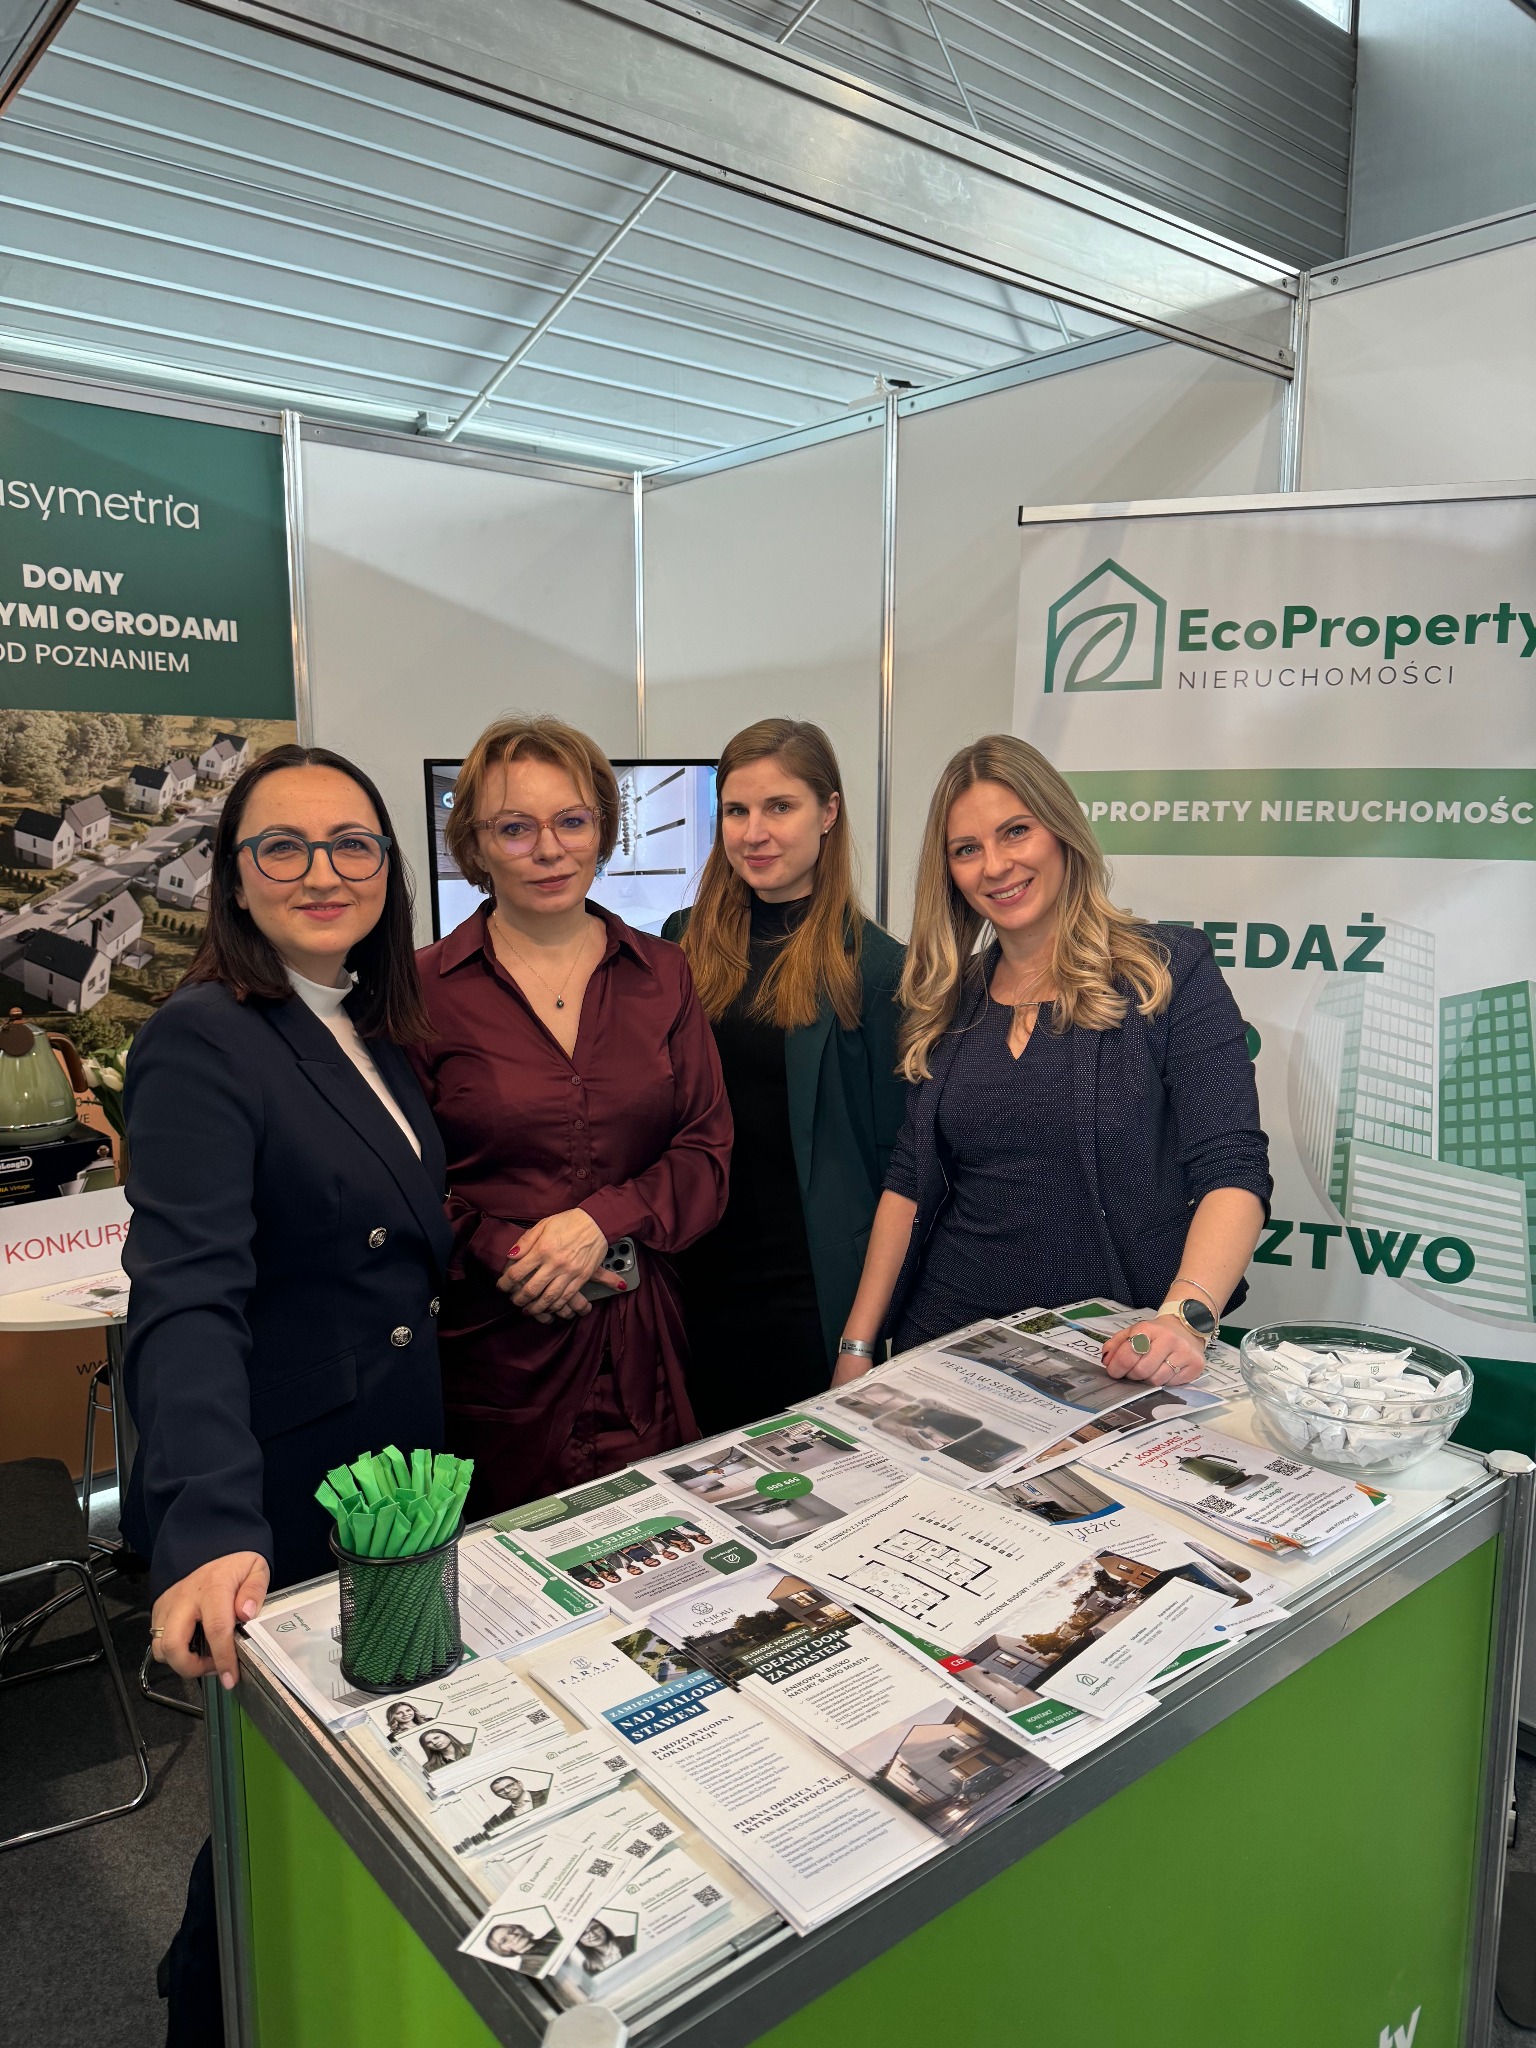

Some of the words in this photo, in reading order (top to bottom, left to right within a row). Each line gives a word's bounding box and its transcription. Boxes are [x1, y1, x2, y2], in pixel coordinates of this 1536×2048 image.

[22, 564, 124, 595] DOMY
[66, 607, 238, 642] OGRODAMI
[1178, 602, 1536, 659] EcoProperty
[35, 644, 190, 672] POZNANIEM
[1178, 661, 1454, 690] NIERUCHOMOŚCI
[1253, 1219, 1476, 1284] ZTWO
[1133, 1434, 1184, 1460] KONKURS
[585, 1541, 603, 1551] TY
[600, 1526, 642, 1546] JESTEŚ
[740, 1643, 775, 1660] BLISKOŚĆ
[772, 1627, 809, 1645] POZNANIA
[751, 1647, 783, 1663] ZIELONA
[780, 1634, 811, 1650] OKOLICA
[755, 1645, 811, 1673] IDEALNY
[810, 1629, 845, 1647] DOM
[556, 1656, 620, 1685] TARASY
[765, 1669, 788, 1682] ZA
[784, 1641, 846, 1673] MIASTEM
[781, 1672, 822, 1694] JANIKOWO
[823, 1658, 850, 1672] BLISKO
[842, 1655, 870, 1671] MIASTA
[608, 1687, 675, 1718] ZAMIESZKAJ
[1025, 1709, 1054, 1723] KONTAKT
[617, 1709, 657, 1729] NAD
[629, 1704, 703, 1740] STAWEM
[650, 1735, 690, 1756] BARDZO
[688, 1713, 735, 1737] WYGODNA
[656, 1729, 718, 1761] LOKALIZACJA
[732, 1807, 771, 1831] PIĘKNA
[768, 1785, 813, 1811] OKOLICA
[816, 1775, 832, 1786] TU
[740, 1806, 791, 1835] AKTYWNIE
[788, 1772, 854, 1809] WYPOCZNIESZ
